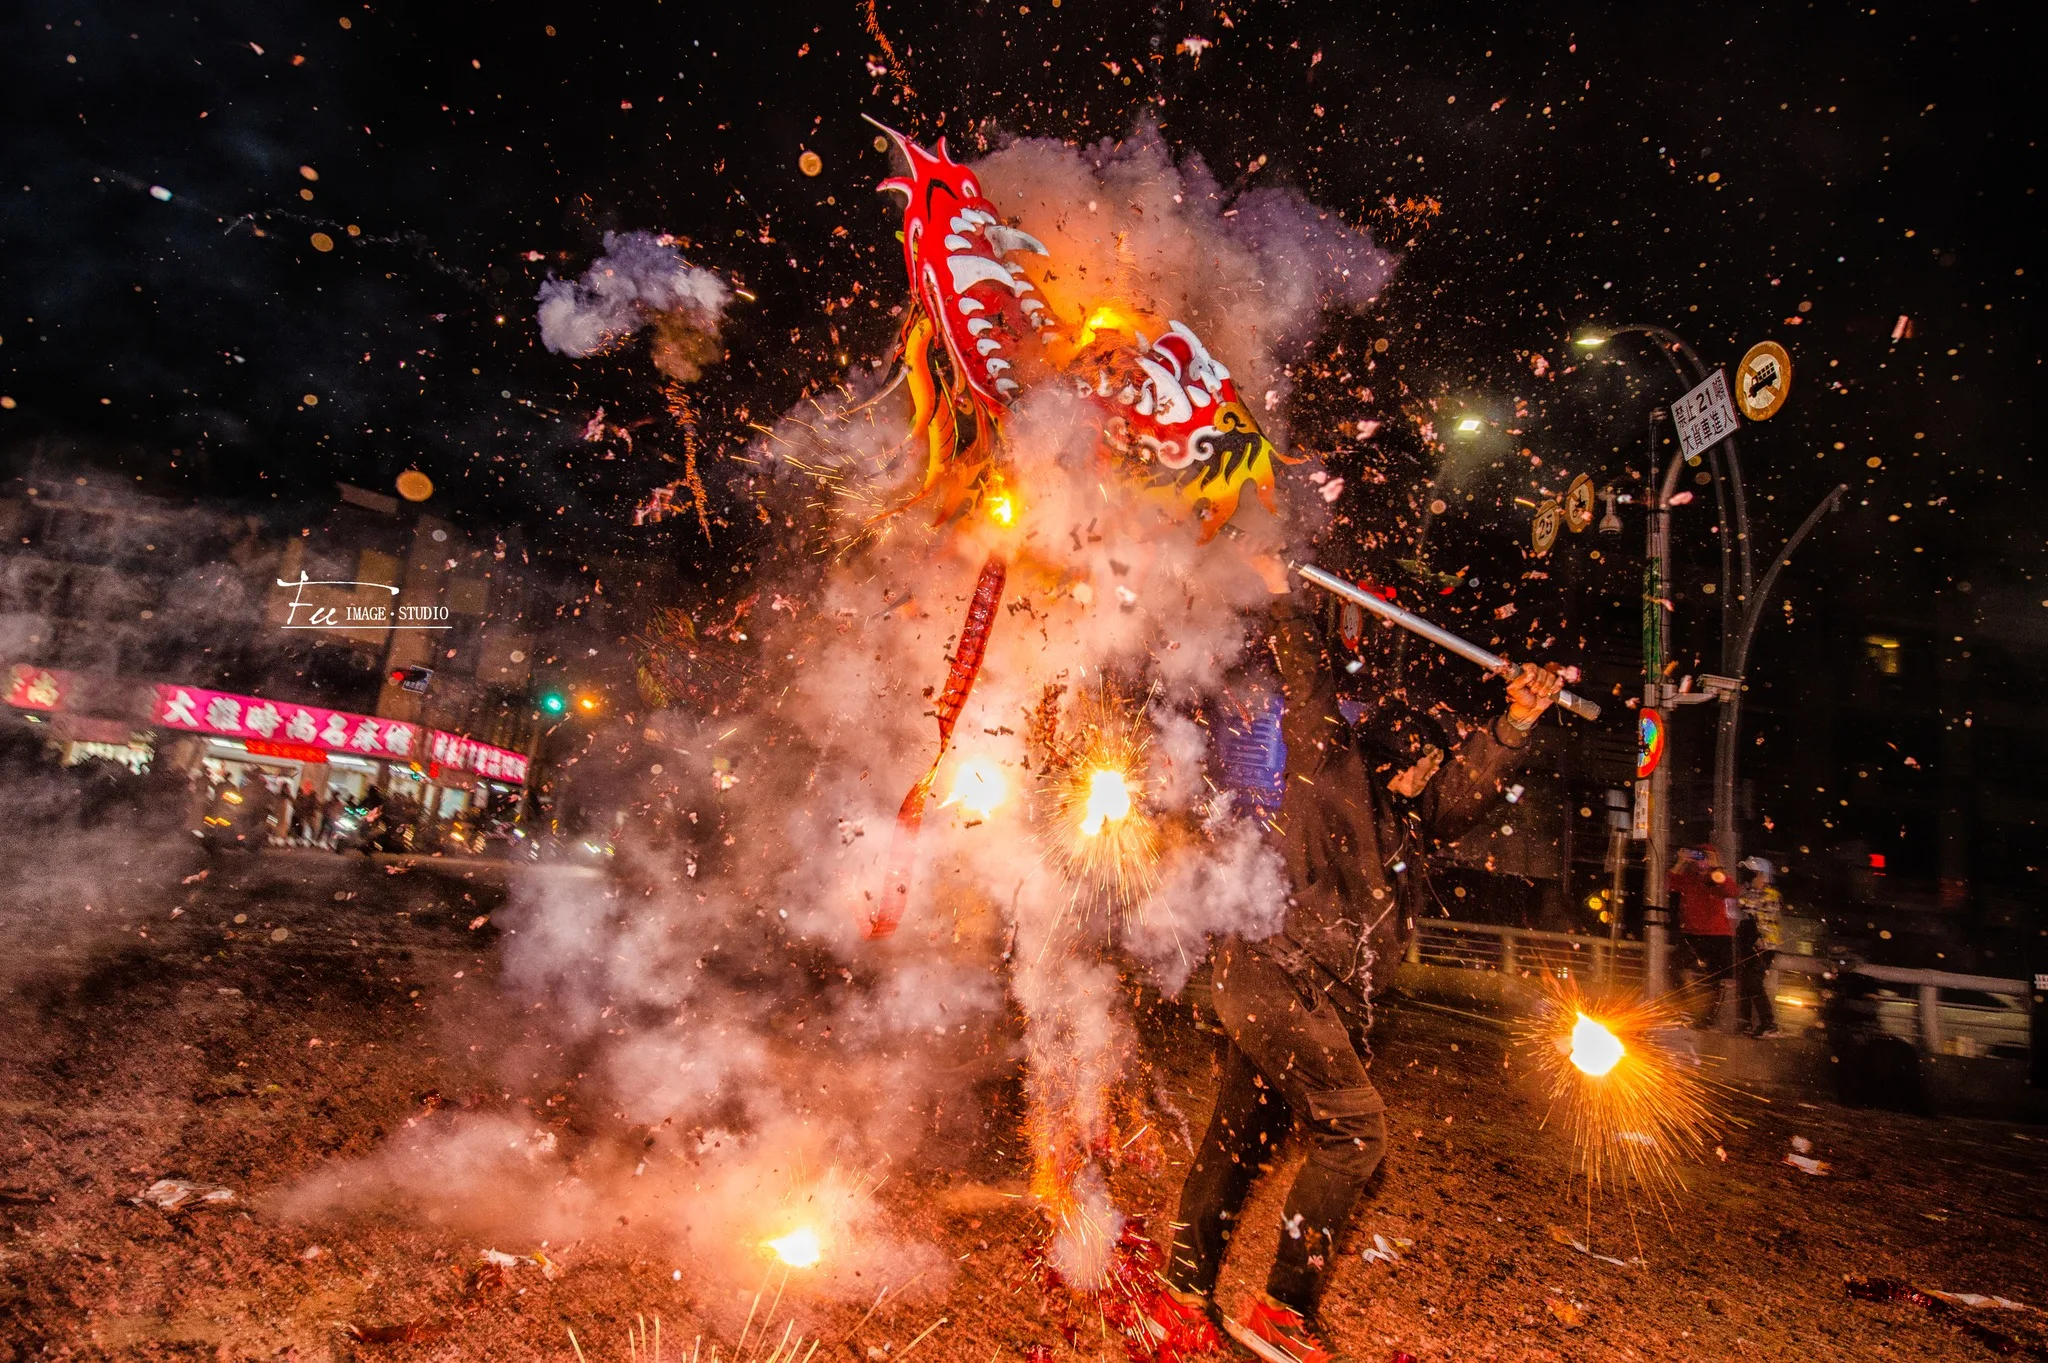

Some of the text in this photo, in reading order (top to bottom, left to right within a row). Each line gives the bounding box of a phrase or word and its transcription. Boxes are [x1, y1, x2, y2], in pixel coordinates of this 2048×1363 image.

[1683, 405, 1733, 454] 大貨車進入
